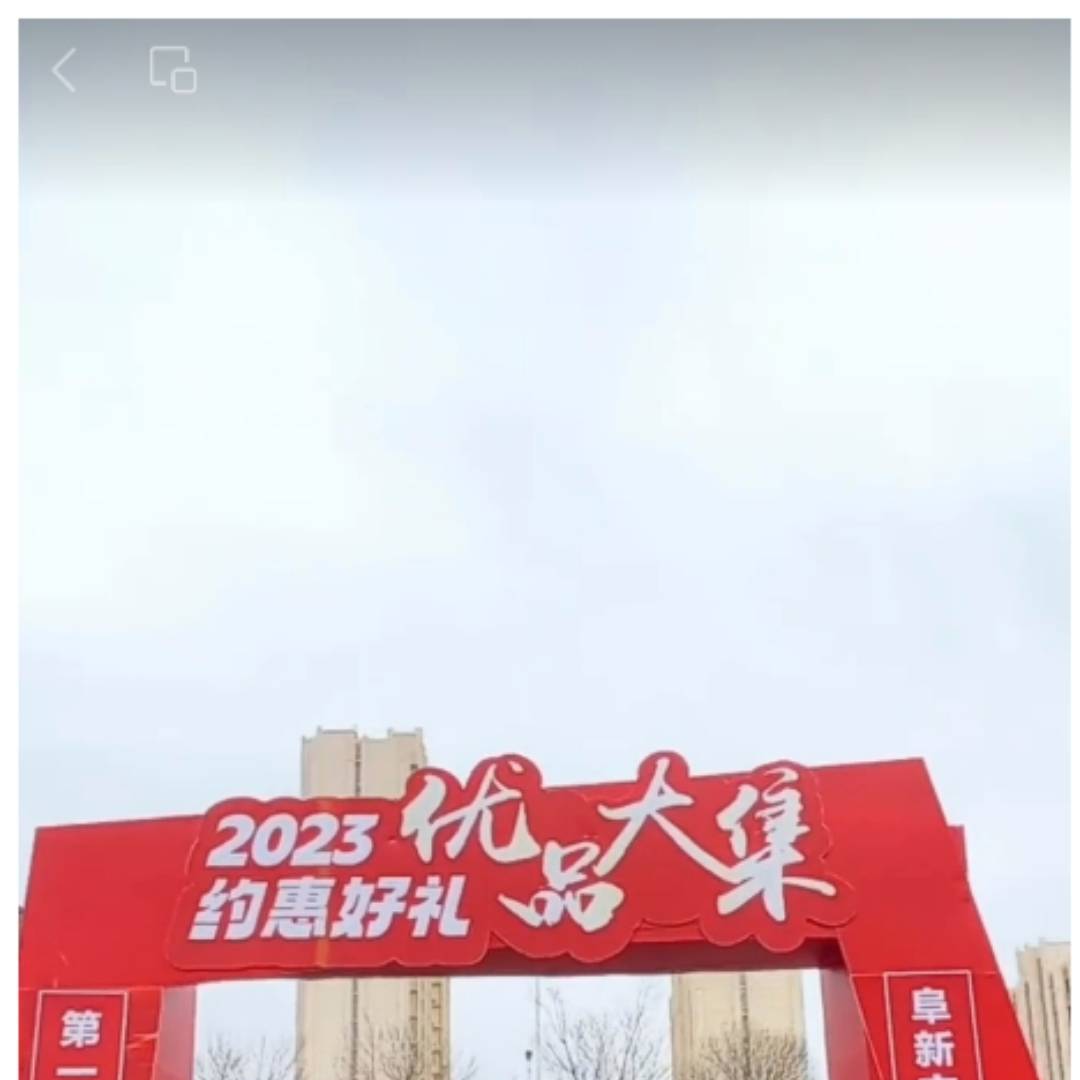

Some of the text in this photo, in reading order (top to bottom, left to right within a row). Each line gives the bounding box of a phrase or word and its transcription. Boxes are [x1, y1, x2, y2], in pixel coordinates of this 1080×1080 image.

[206, 812, 379, 867] 2023
[401, 757, 836, 933] 优品大集
[188, 876, 470, 940] 约惠好礼
